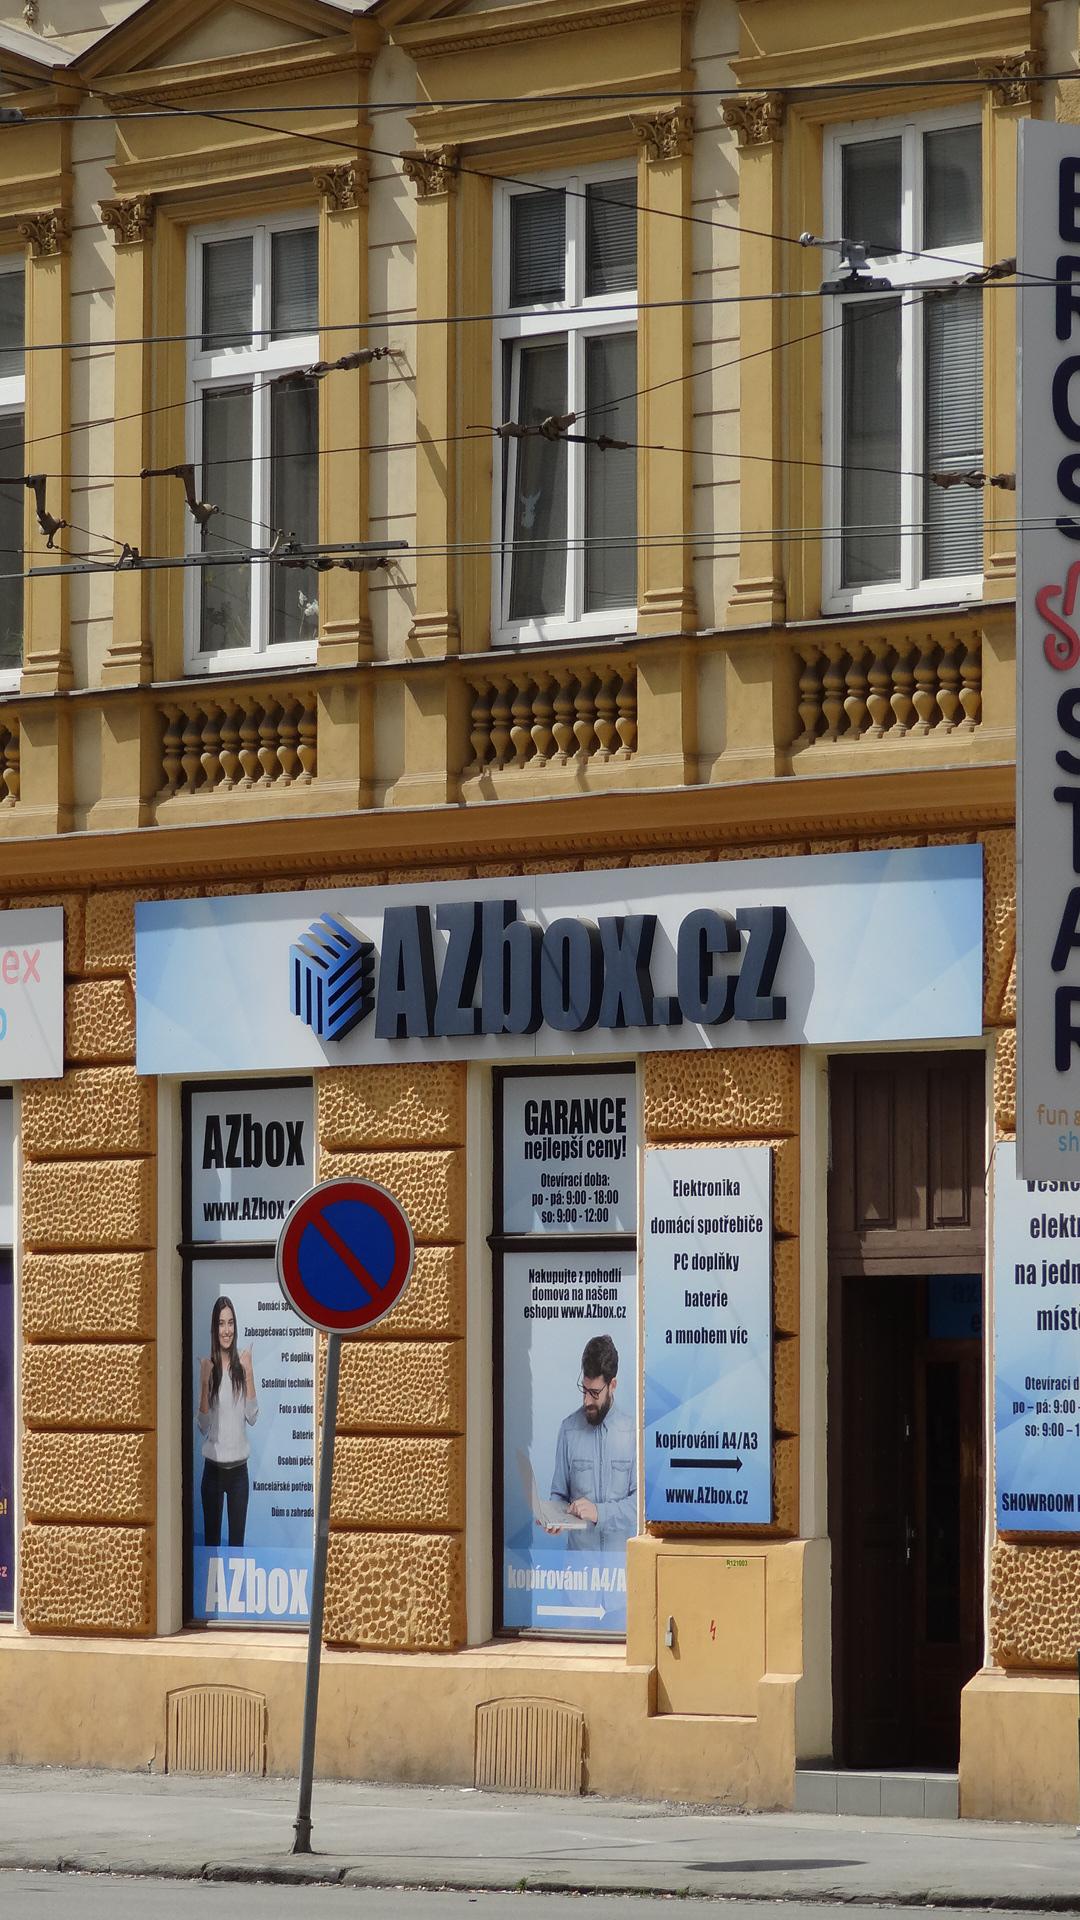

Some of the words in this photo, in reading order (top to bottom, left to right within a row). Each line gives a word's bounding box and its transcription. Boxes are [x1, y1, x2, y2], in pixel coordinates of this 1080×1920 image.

[375, 899, 787, 1039] AZbox.cz
[525, 1097, 627, 1136] GARANCE
[1036, 1104, 1068, 1126] fun
[203, 1113, 305, 1169] AZbox
[524, 1136, 583, 1162] nejlepší
[587, 1136, 626, 1160] ceny!
[541, 1173, 583, 1188] Otevírací
[584, 1172, 610, 1187] doba:
[673, 1179, 740, 1197] Elektronika
[532, 1193, 544, 1207] po
[551, 1192, 565, 1207] pá:
[566, 1190, 587, 1205] 9:00
[594, 1190, 619, 1205] 18:00
[542, 1211, 555, 1223] so:
[557, 1209, 577, 1223] 9:00
[584, 1208, 609, 1222] 12:00
[651, 1217, 695, 1235] domácí
[698, 1215, 763, 1235] spotřebiče
[674, 1253, 688, 1270] PC
[692, 1252, 740, 1272] doplňky
[529, 1269, 577, 1286] Nakupujte
[578, 1273, 583, 1283] z
[584, 1268, 622, 1284] pohodlí
[1015, 1264, 1036, 1285] na
[532, 1287, 569, 1301] domova
[571, 1290, 584, 1301] na
[585, 1286, 618, 1301] našem
[685, 1290, 728, 1307] baterie
[524, 1305, 559, 1320] eshopu
[561, 1304, 626, 1319] www.AZbox.cz
[666, 1331, 672, 1344] a
[676, 1327, 727, 1344] mnohem
[730, 1326, 748, 1345] víc
[282, 1353, 289, 1362] PC
[1025, 1376, 1071, 1391] Otevírací
[279, 1404, 291, 1414] Foto
[1013, 1401, 1025, 1414] po
[1036, 1399, 1051, 1415] pá:
[1054, 1400, 1076, 1414] 9:00
[1025, 1424, 1040, 1437] so:
[1042, 1423, 1064, 1437] 9:00
[656, 1431, 719, 1450] kopírování
[722, 1432, 758, 1450] A4/A3
[666, 1486, 749, 1505] www.AZbox.cz
[1002, 1492, 1074, 1512] SHOWROOM
[206, 1557, 308, 1614] AZbox
[508, 1565, 588, 1591] kopírování
